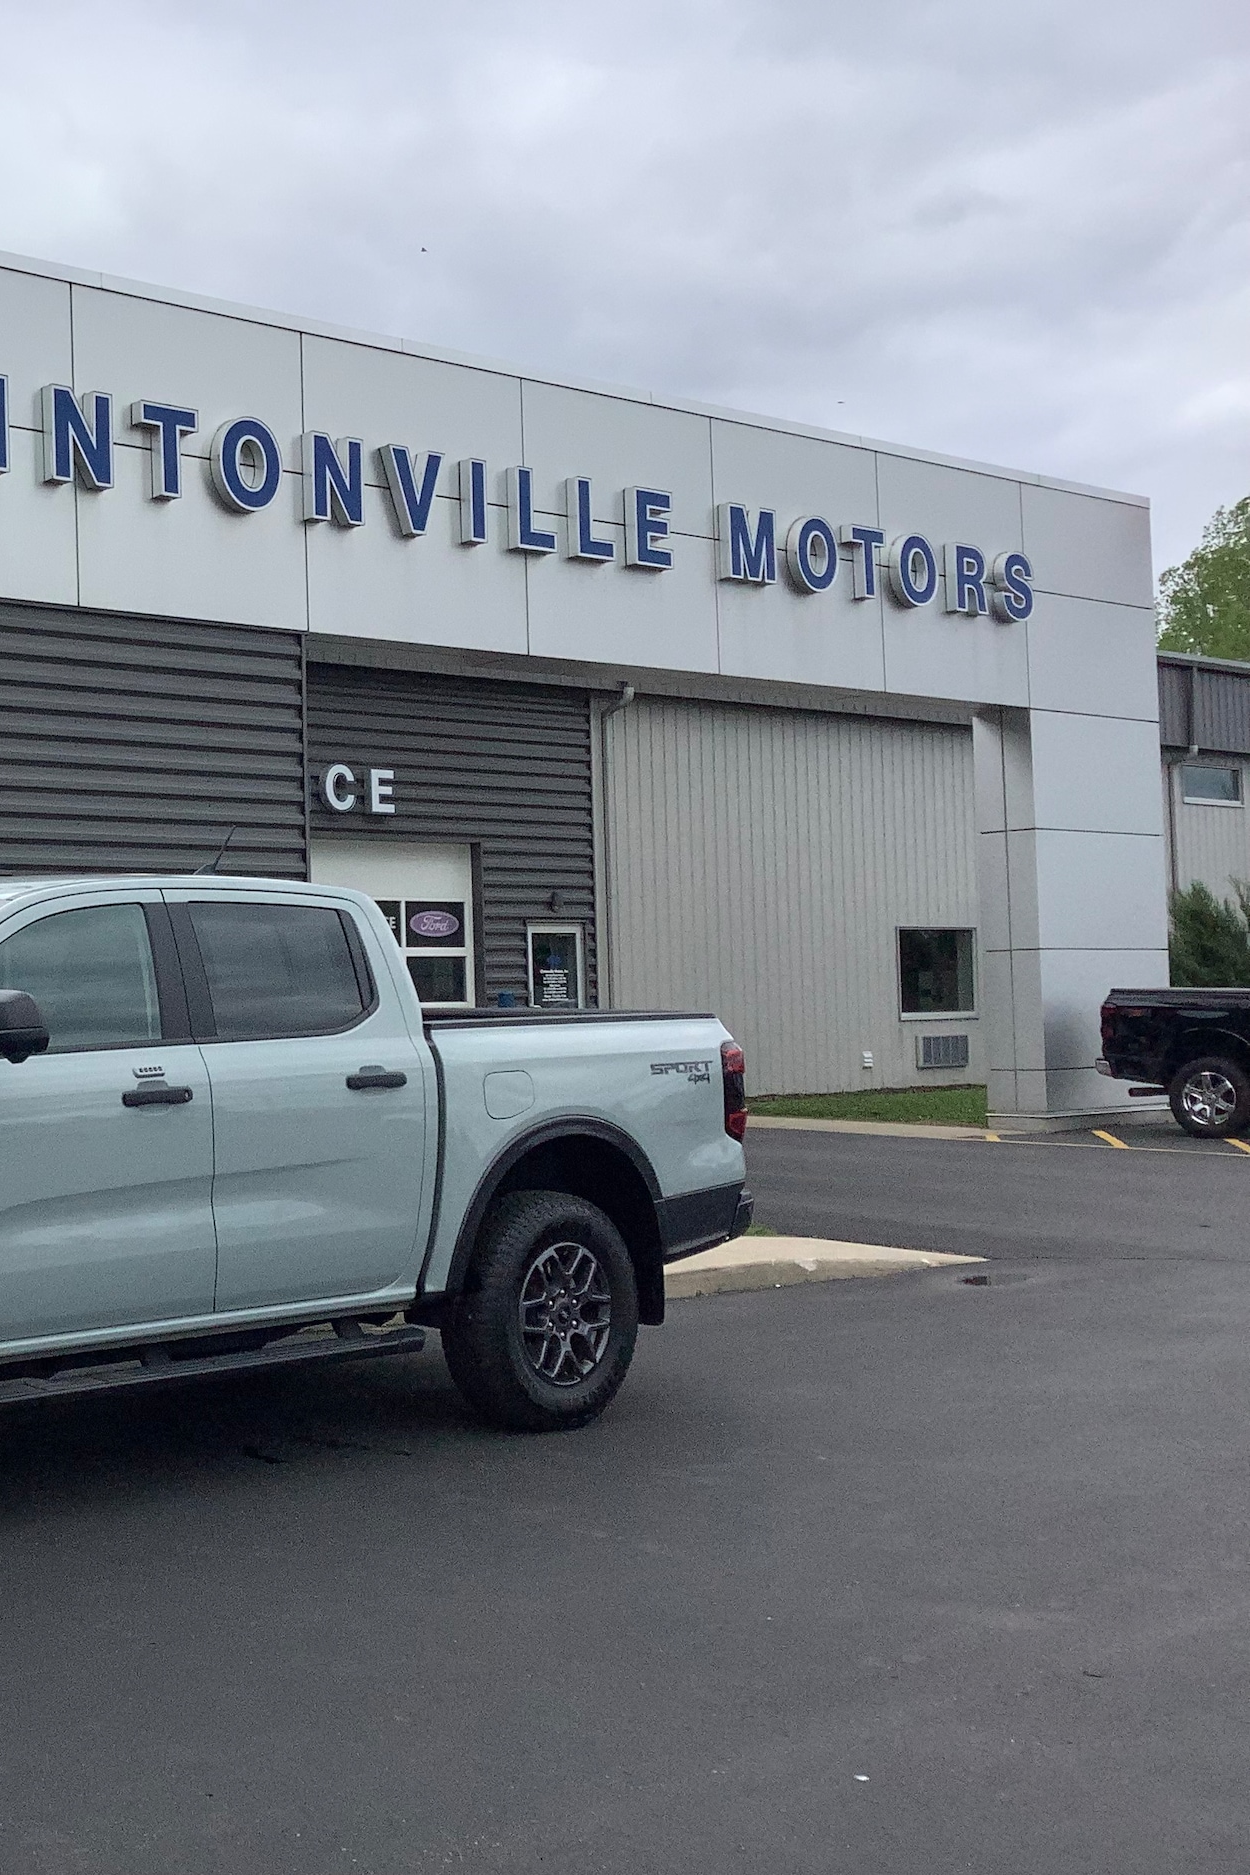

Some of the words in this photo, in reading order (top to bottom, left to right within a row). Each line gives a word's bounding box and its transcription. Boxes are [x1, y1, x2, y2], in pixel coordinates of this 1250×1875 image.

[719, 502, 1034, 623] MOTORS
[420, 915, 449, 931] Ford
[650, 1060, 714, 1075] SPORT
